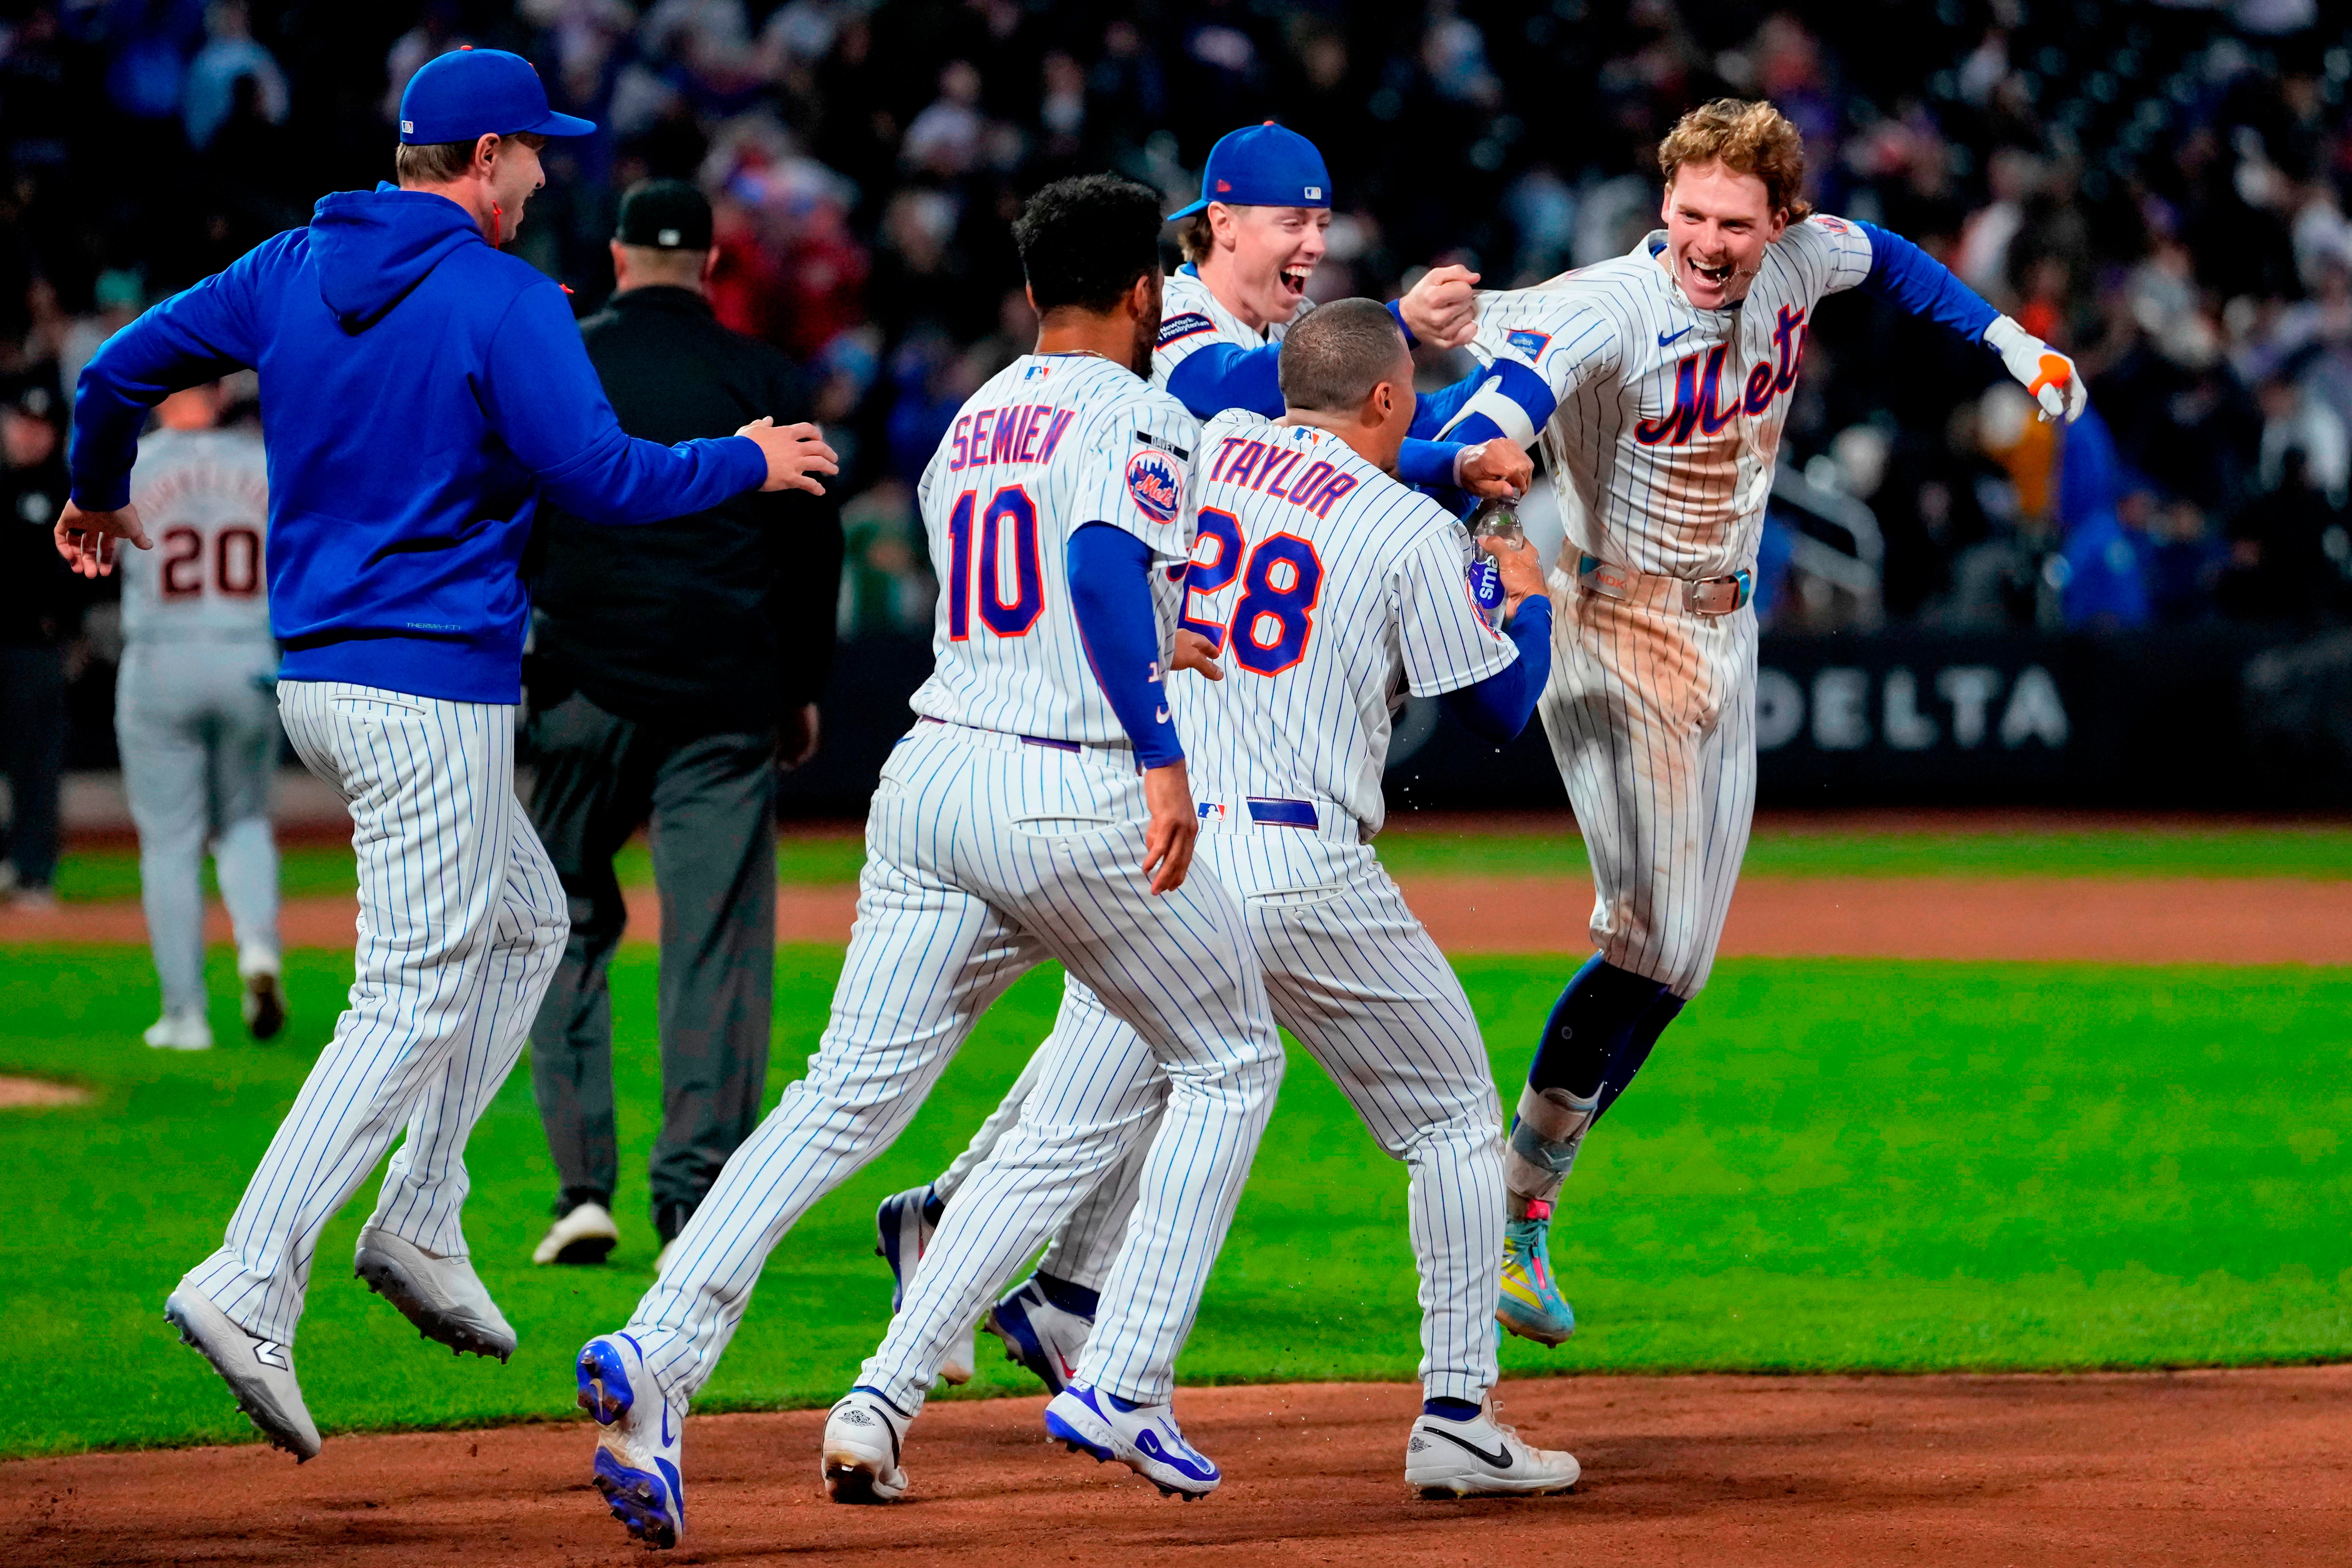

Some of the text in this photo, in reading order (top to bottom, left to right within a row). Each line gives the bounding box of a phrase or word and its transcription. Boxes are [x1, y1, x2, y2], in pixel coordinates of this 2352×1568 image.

[1162, 321, 1209, 338] Presbyterian
[950, 404, 1075, 472] SEMIEN
[1151, 435, 1175, 454] DAVEY
[1135, 473, 1175, 508] Mets
[1210, 438, 1358, 520] TAYLOR
[160, 523, 260, 603] 20
[949, 484, 1045, 642] 10
[1166, 505, 1325, 677] 28
[1479, 555, 1498, 600] sma
[406, 622, 461, 631] THERMA-FIT
[1755, 665, 2069, 751] DELTA
